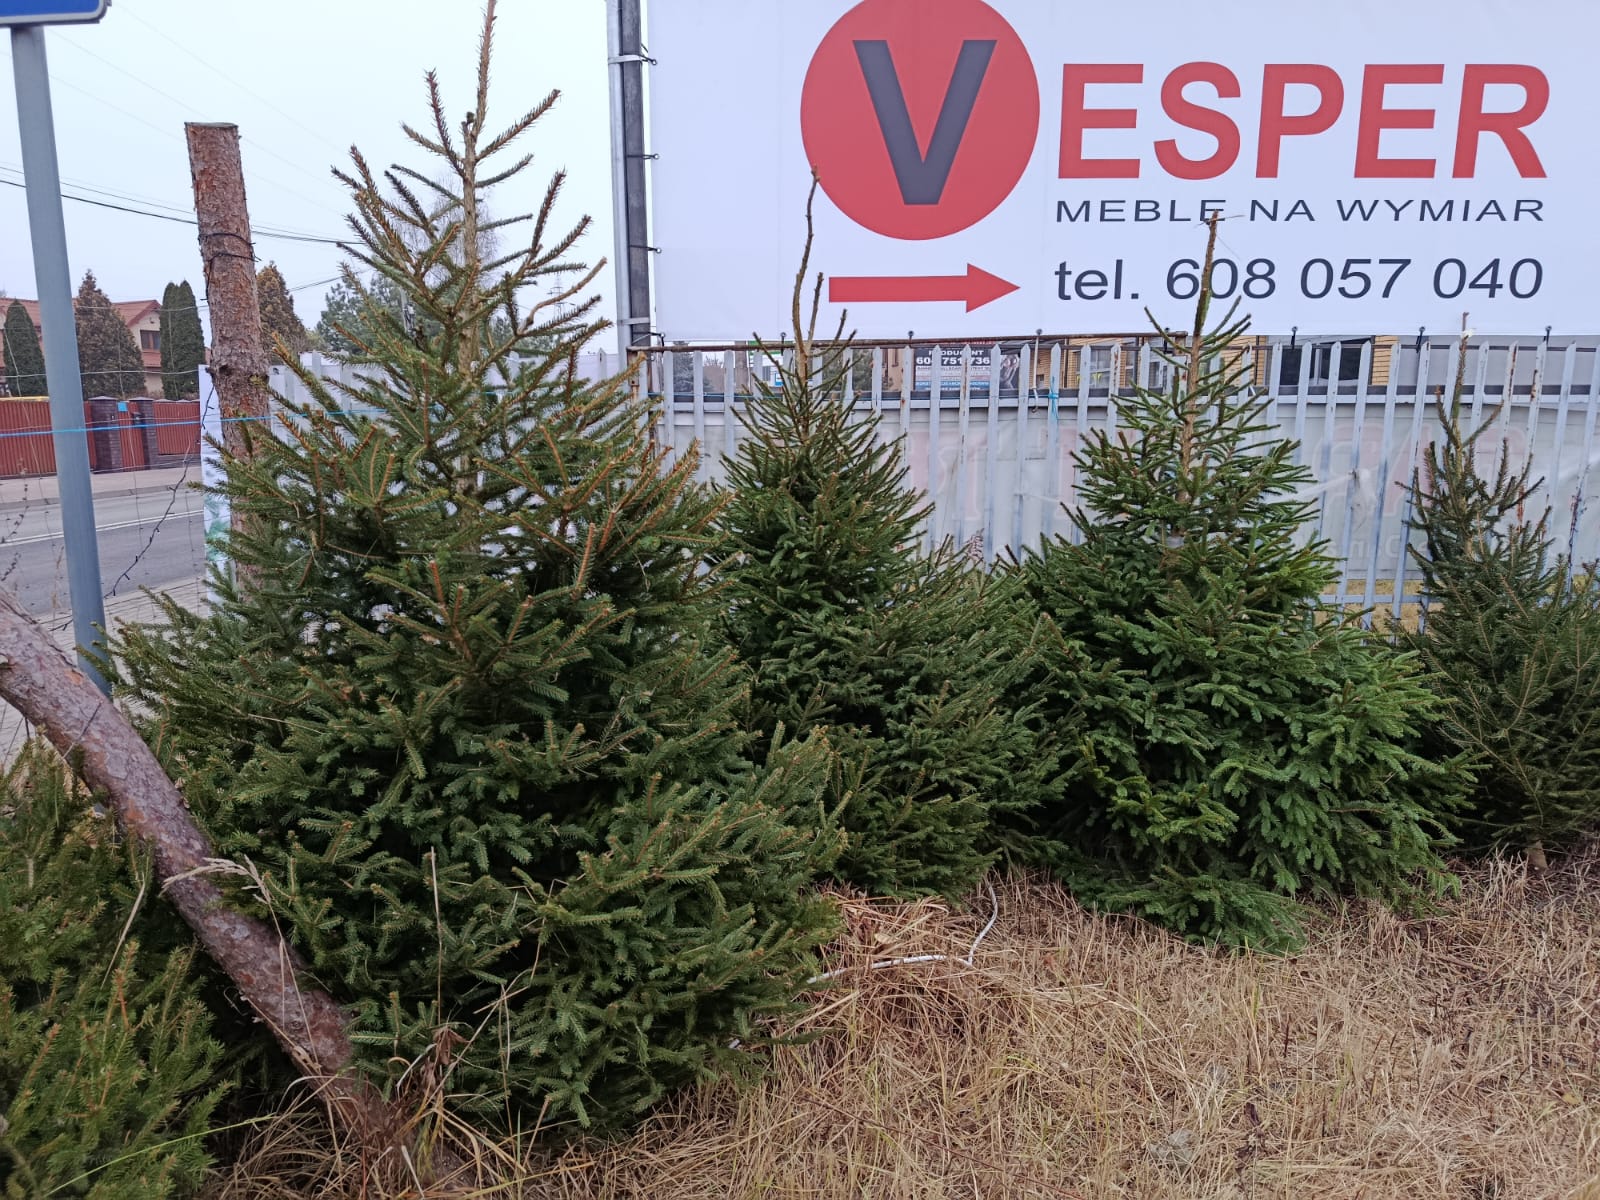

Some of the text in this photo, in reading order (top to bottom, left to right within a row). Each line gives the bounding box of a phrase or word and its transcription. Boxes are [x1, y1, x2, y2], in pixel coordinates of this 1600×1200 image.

[1056, 199, 1544, 222] MEBLE NA WYMIAR
[1054, 258, 1544, 301] tel. 608 057 040
[916, 356, 936, 365] 60
